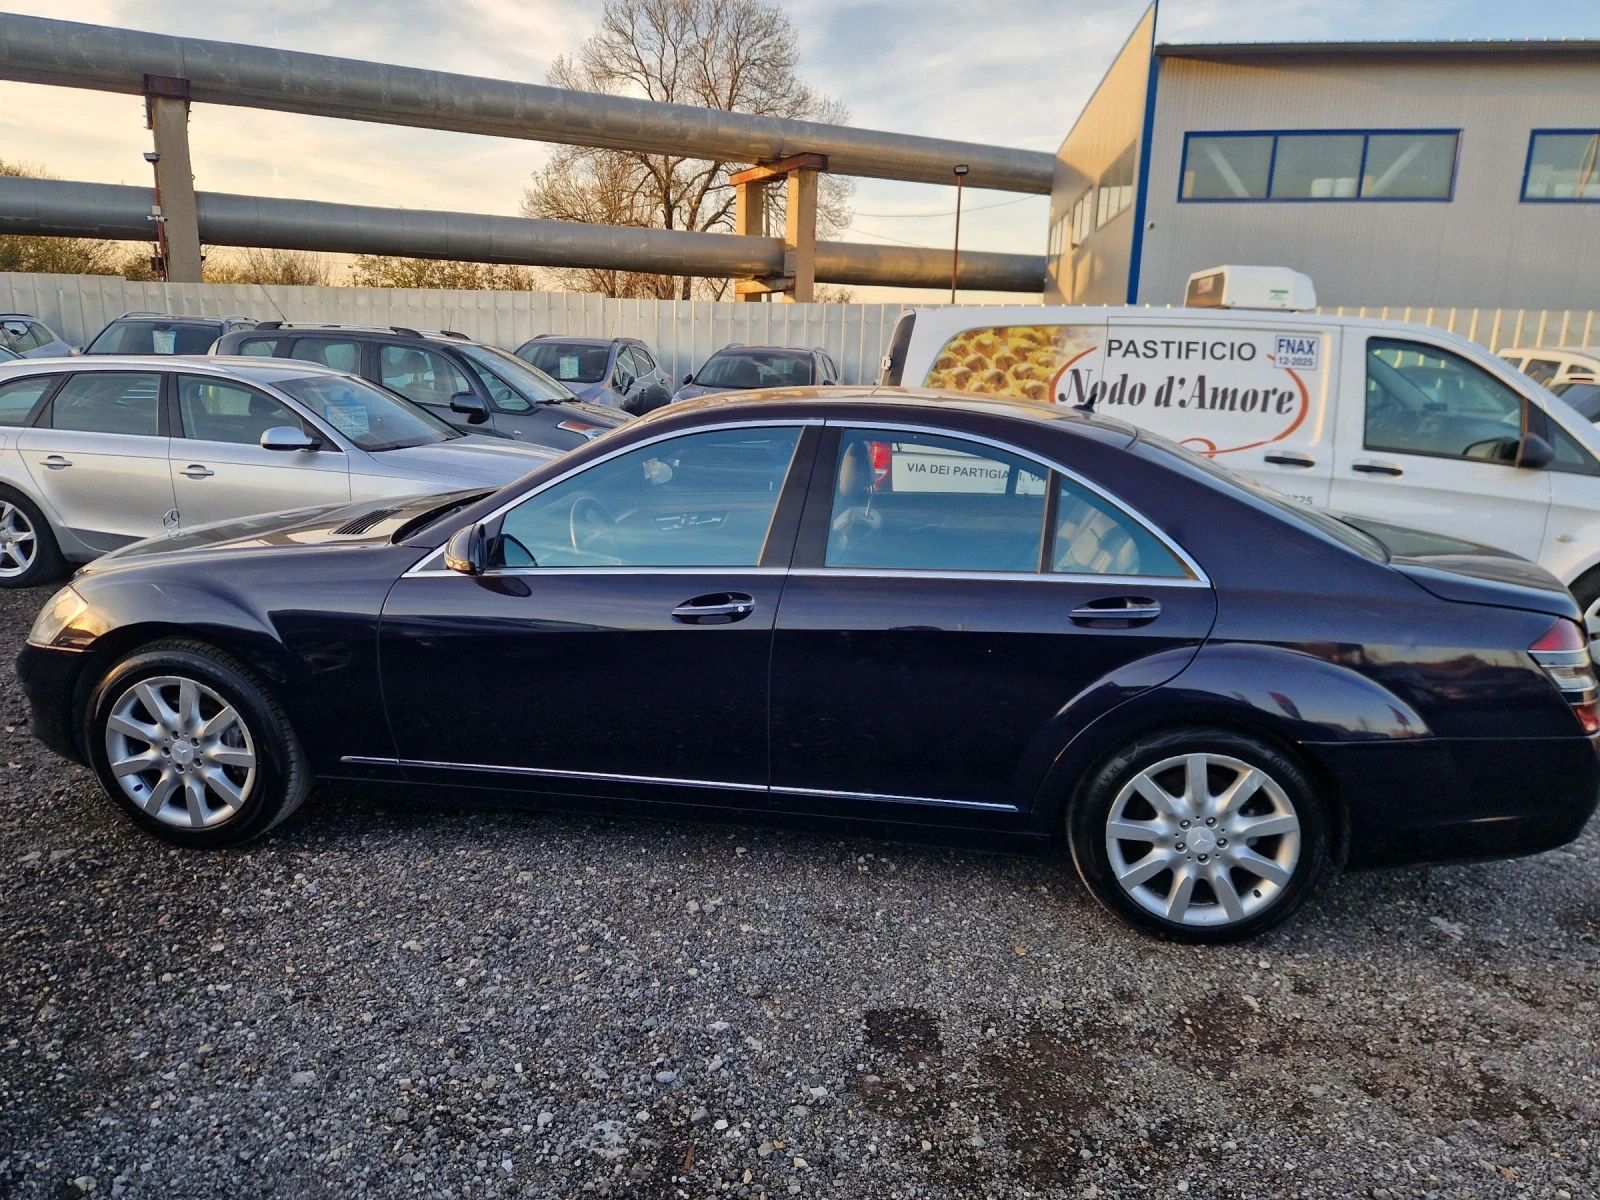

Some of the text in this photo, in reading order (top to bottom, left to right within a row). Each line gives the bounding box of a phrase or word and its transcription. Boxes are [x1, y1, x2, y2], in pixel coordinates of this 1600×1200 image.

[1106, 339, 1257, 362] PASTIFICIO
[1277, 338, 1316, 356] FNAX
[1278, 356, 1314, 367] 12-2025
[1058, 368, 1295, 415] Nodo d'Amore
[906, 462, 927, 474] VIA
[930, 464, 950, 475] DEI
